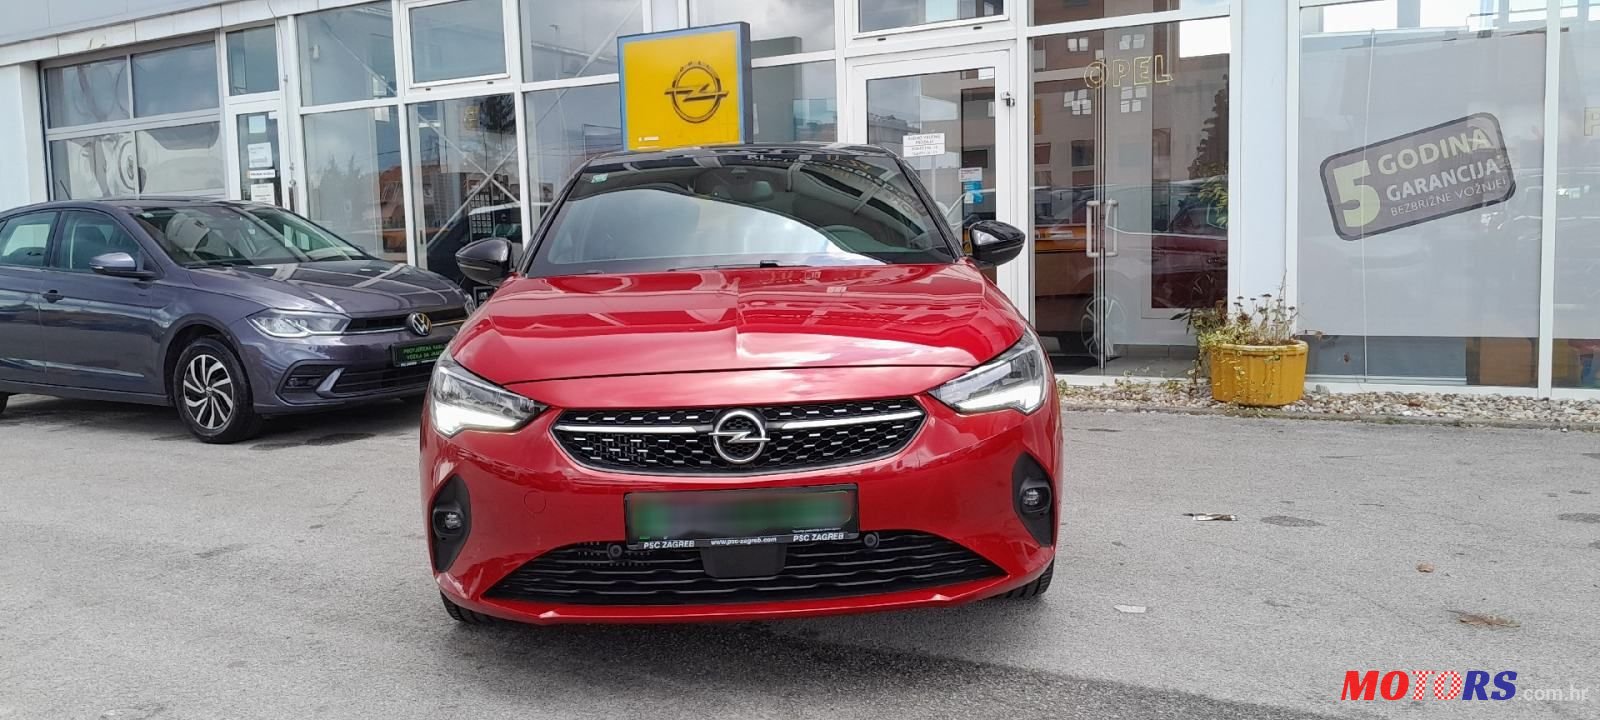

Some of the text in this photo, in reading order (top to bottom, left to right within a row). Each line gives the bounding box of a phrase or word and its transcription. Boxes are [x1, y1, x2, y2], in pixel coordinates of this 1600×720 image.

[1083, 54, 1174, 89] OPEL
[1377, 127, 1490, 176] GODINA
[1333, 158, 1381, 228] 5
[1386, 158, 1501, 202] GARANCIJA
[1390, 191, 1454, 217] BEZBRIŽNE
[643, 540, 695, 549] PSC ZAGREB
[711, 536, 777, 546] www.psc-zagreb.com
[811, 532, 844, 541] ZAGREB
